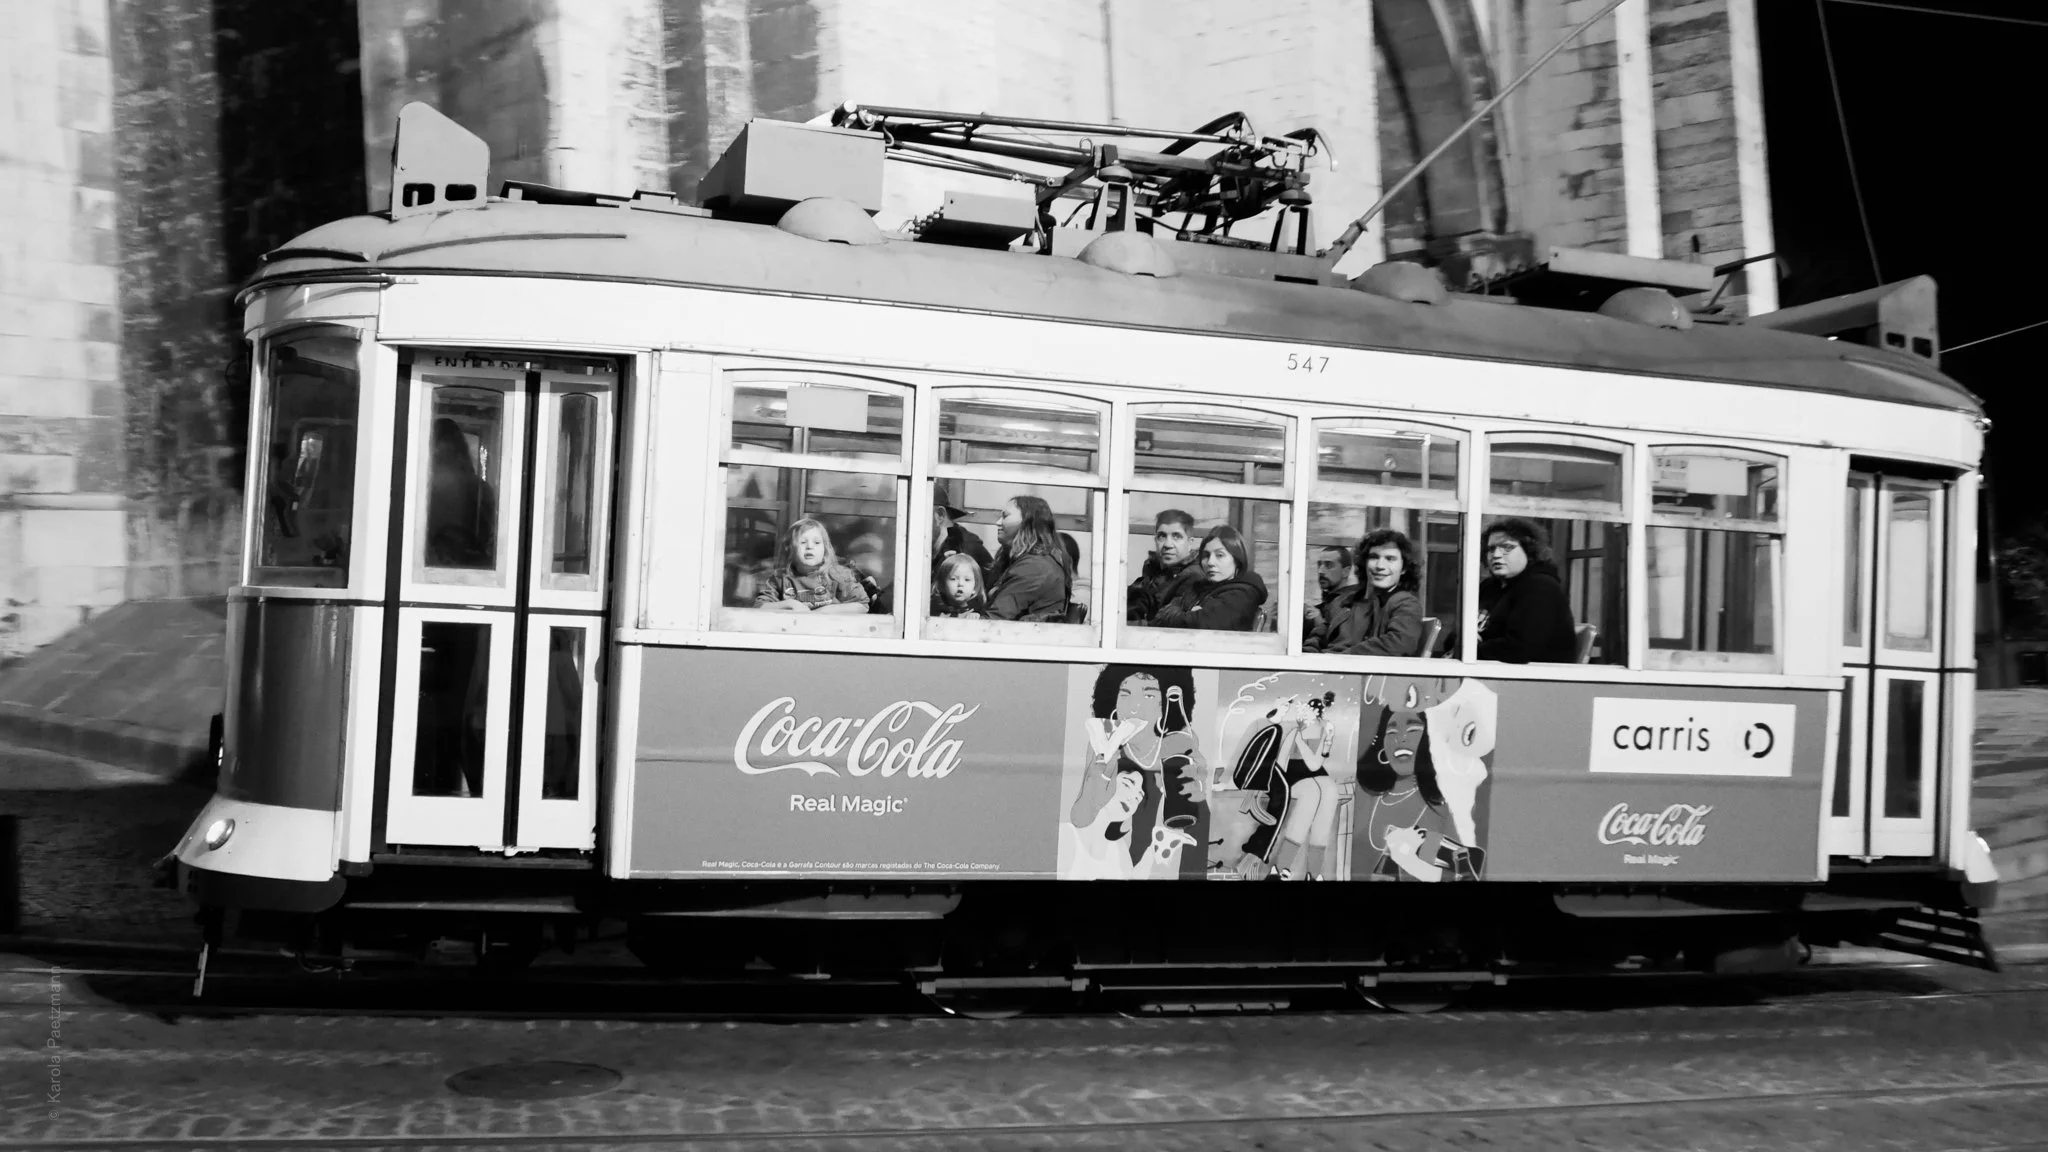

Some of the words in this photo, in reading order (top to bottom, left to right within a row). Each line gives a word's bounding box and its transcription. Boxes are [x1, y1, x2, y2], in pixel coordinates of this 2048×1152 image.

[1287, 353, 1330, 373] 547
[734, 696, 981, 778] Coca-Cola
[1613, 717, 1710, 751] carris
[790, 794, 836, 812] Real
[1598, 803, 1714, 845] Coca-Cola
[702, 860, 717, 868] Real
[741, 860, 776, 869] Coca-Cola
[789, 861, 813, 869] Garrafa
[814, 861, 841, 869] Contour
[855, 862, 878, 870] marcas
[924, 862, 936, 870] The
[937, 862, 969, 870] Coca-Cola
